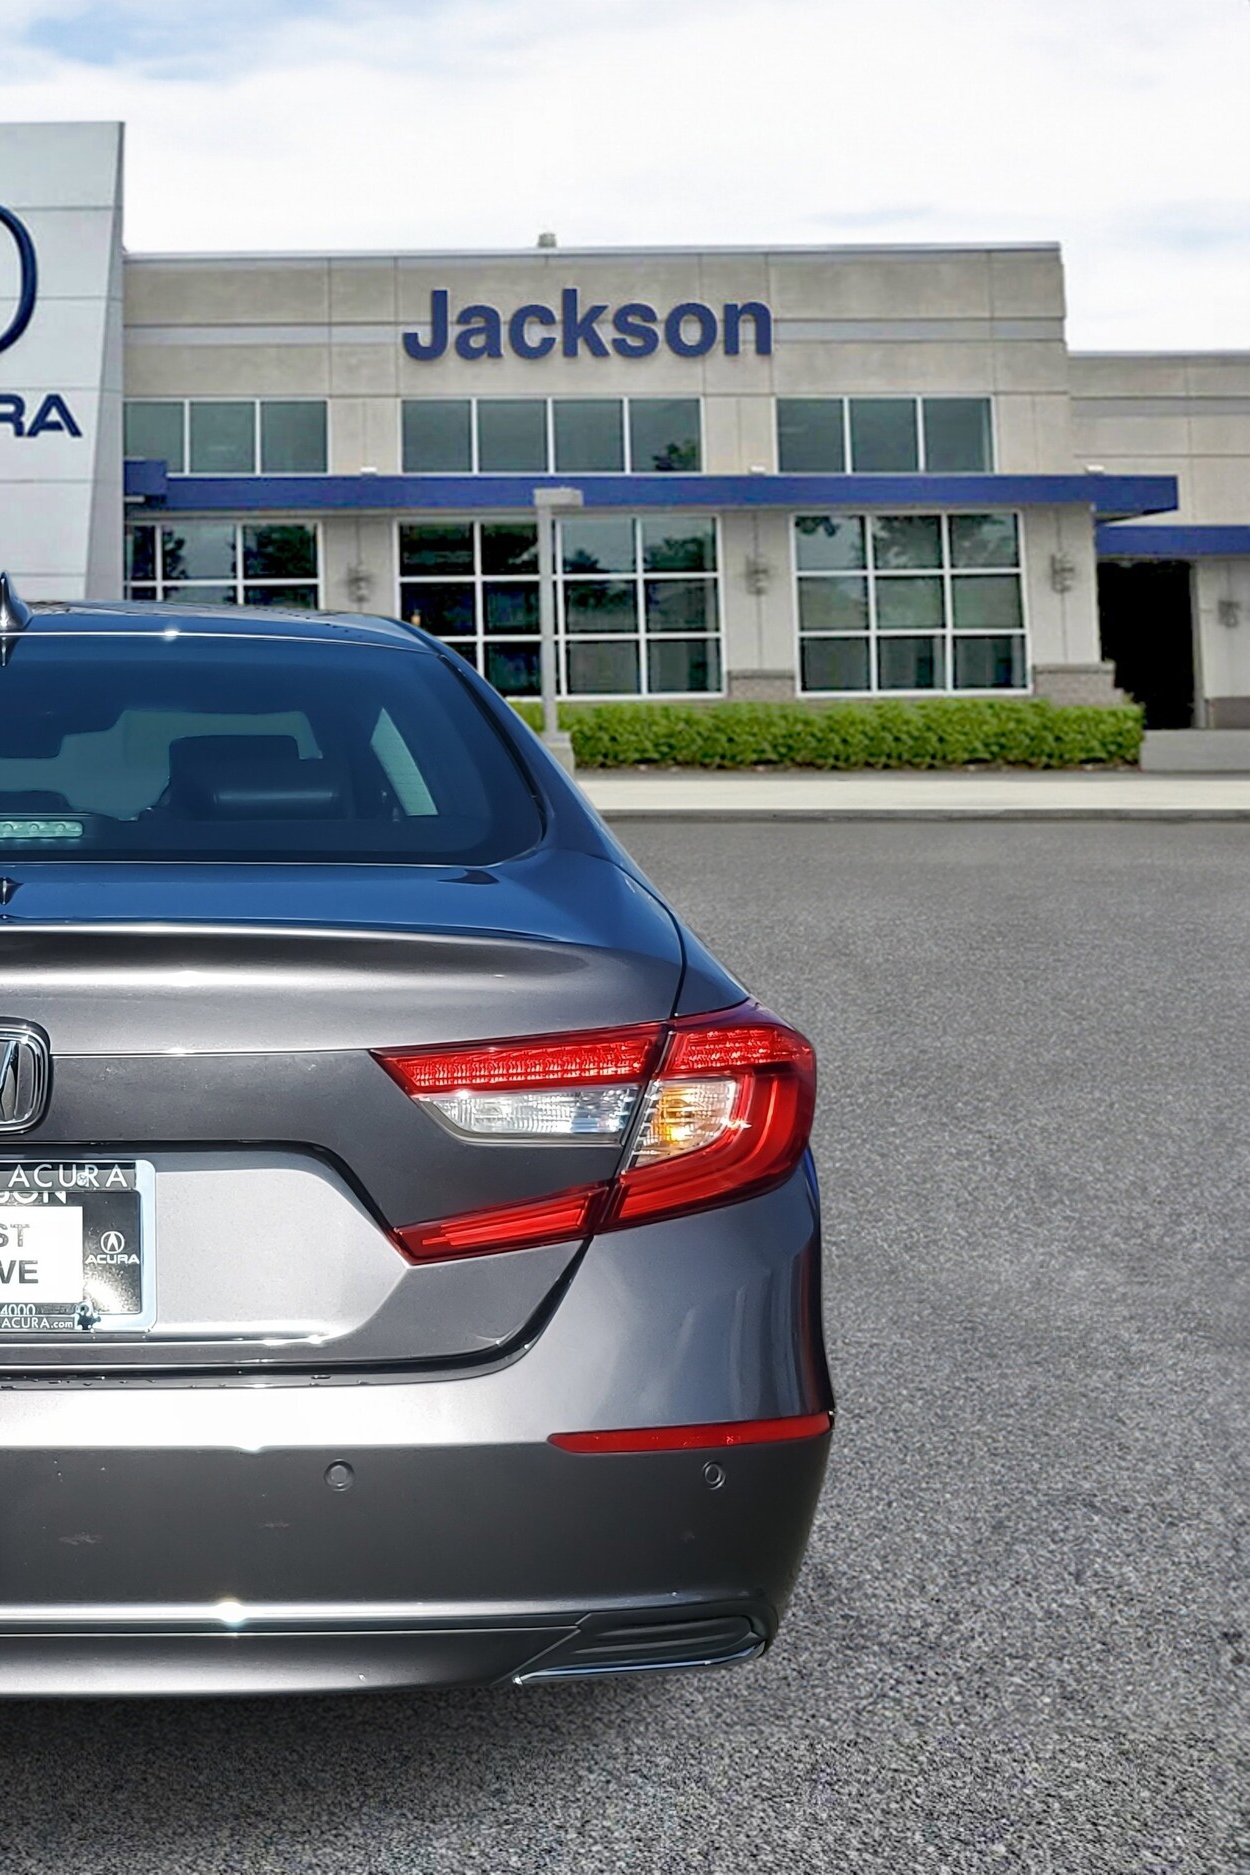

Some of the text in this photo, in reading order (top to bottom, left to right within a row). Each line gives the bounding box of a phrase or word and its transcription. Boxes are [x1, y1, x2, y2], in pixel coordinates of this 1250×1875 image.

[402, 288, 772, 361] Jackson
[8, 1163, 128, 1188] ACURA
[84, 1253, 140, 1265] ACURA
